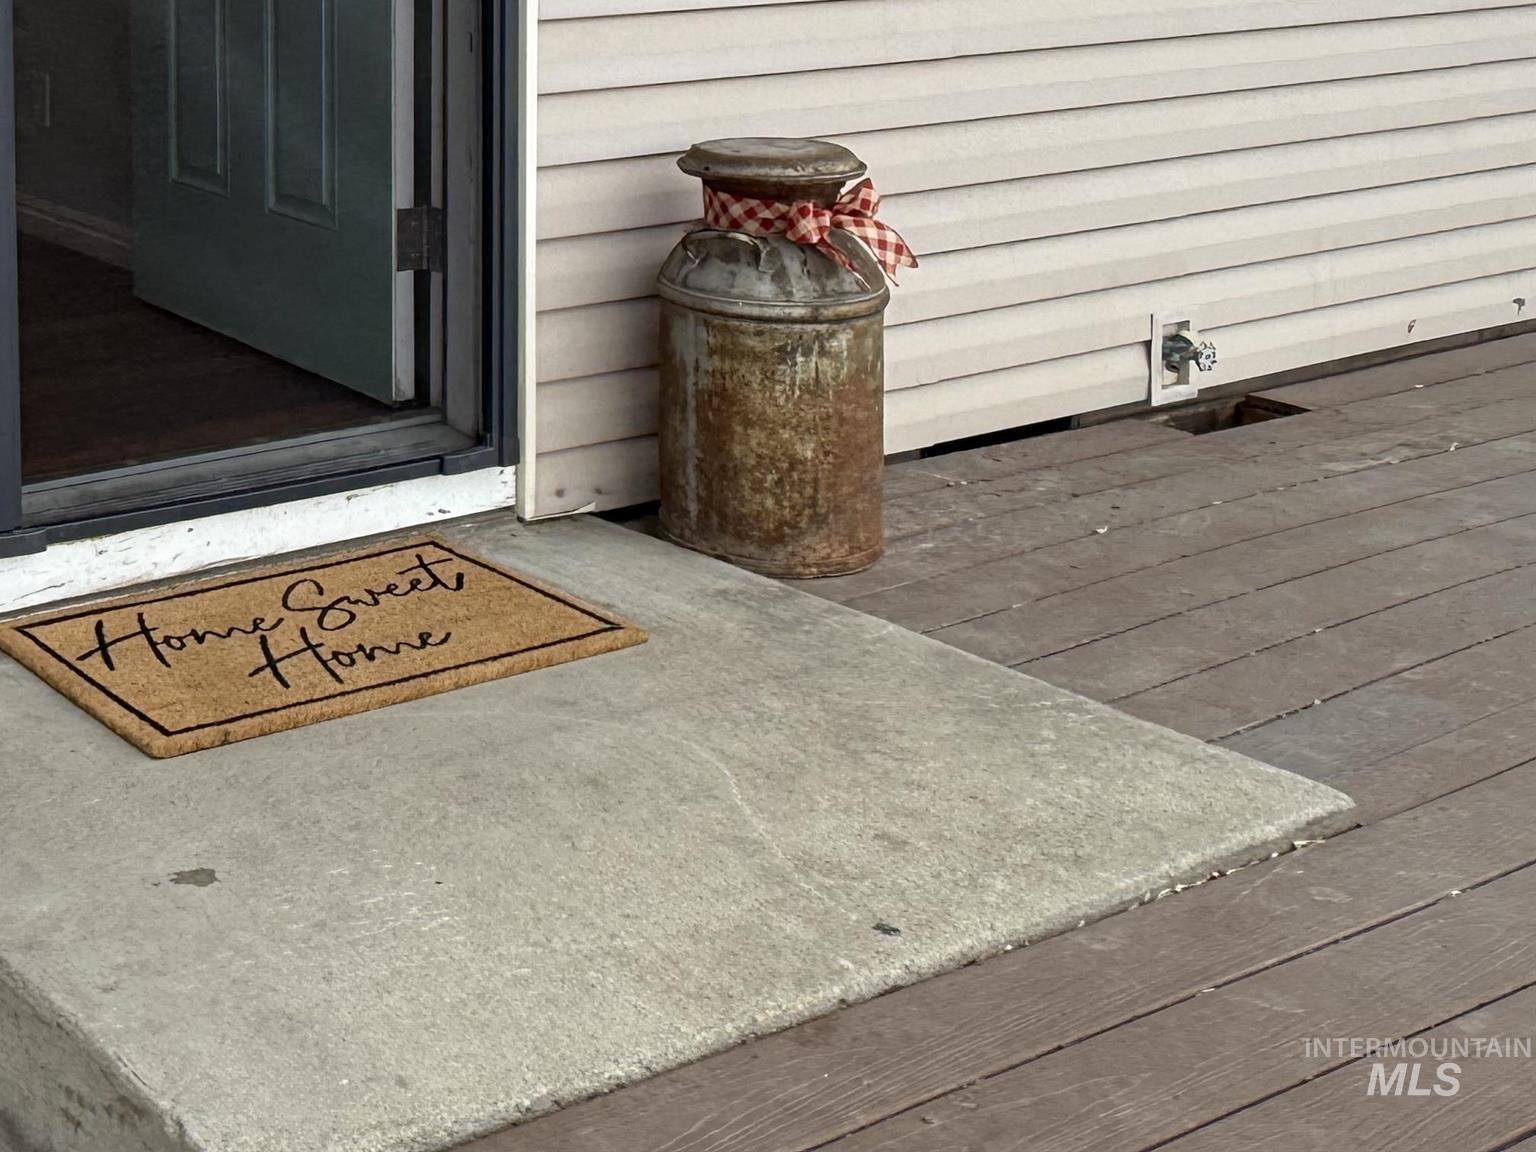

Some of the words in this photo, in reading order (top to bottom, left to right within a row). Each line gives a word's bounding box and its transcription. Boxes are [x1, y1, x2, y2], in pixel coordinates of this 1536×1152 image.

[75, 612, 284, 671] Home
[280, 553, 465, 632] Sweet
[249, 625, 451, 689] Home
